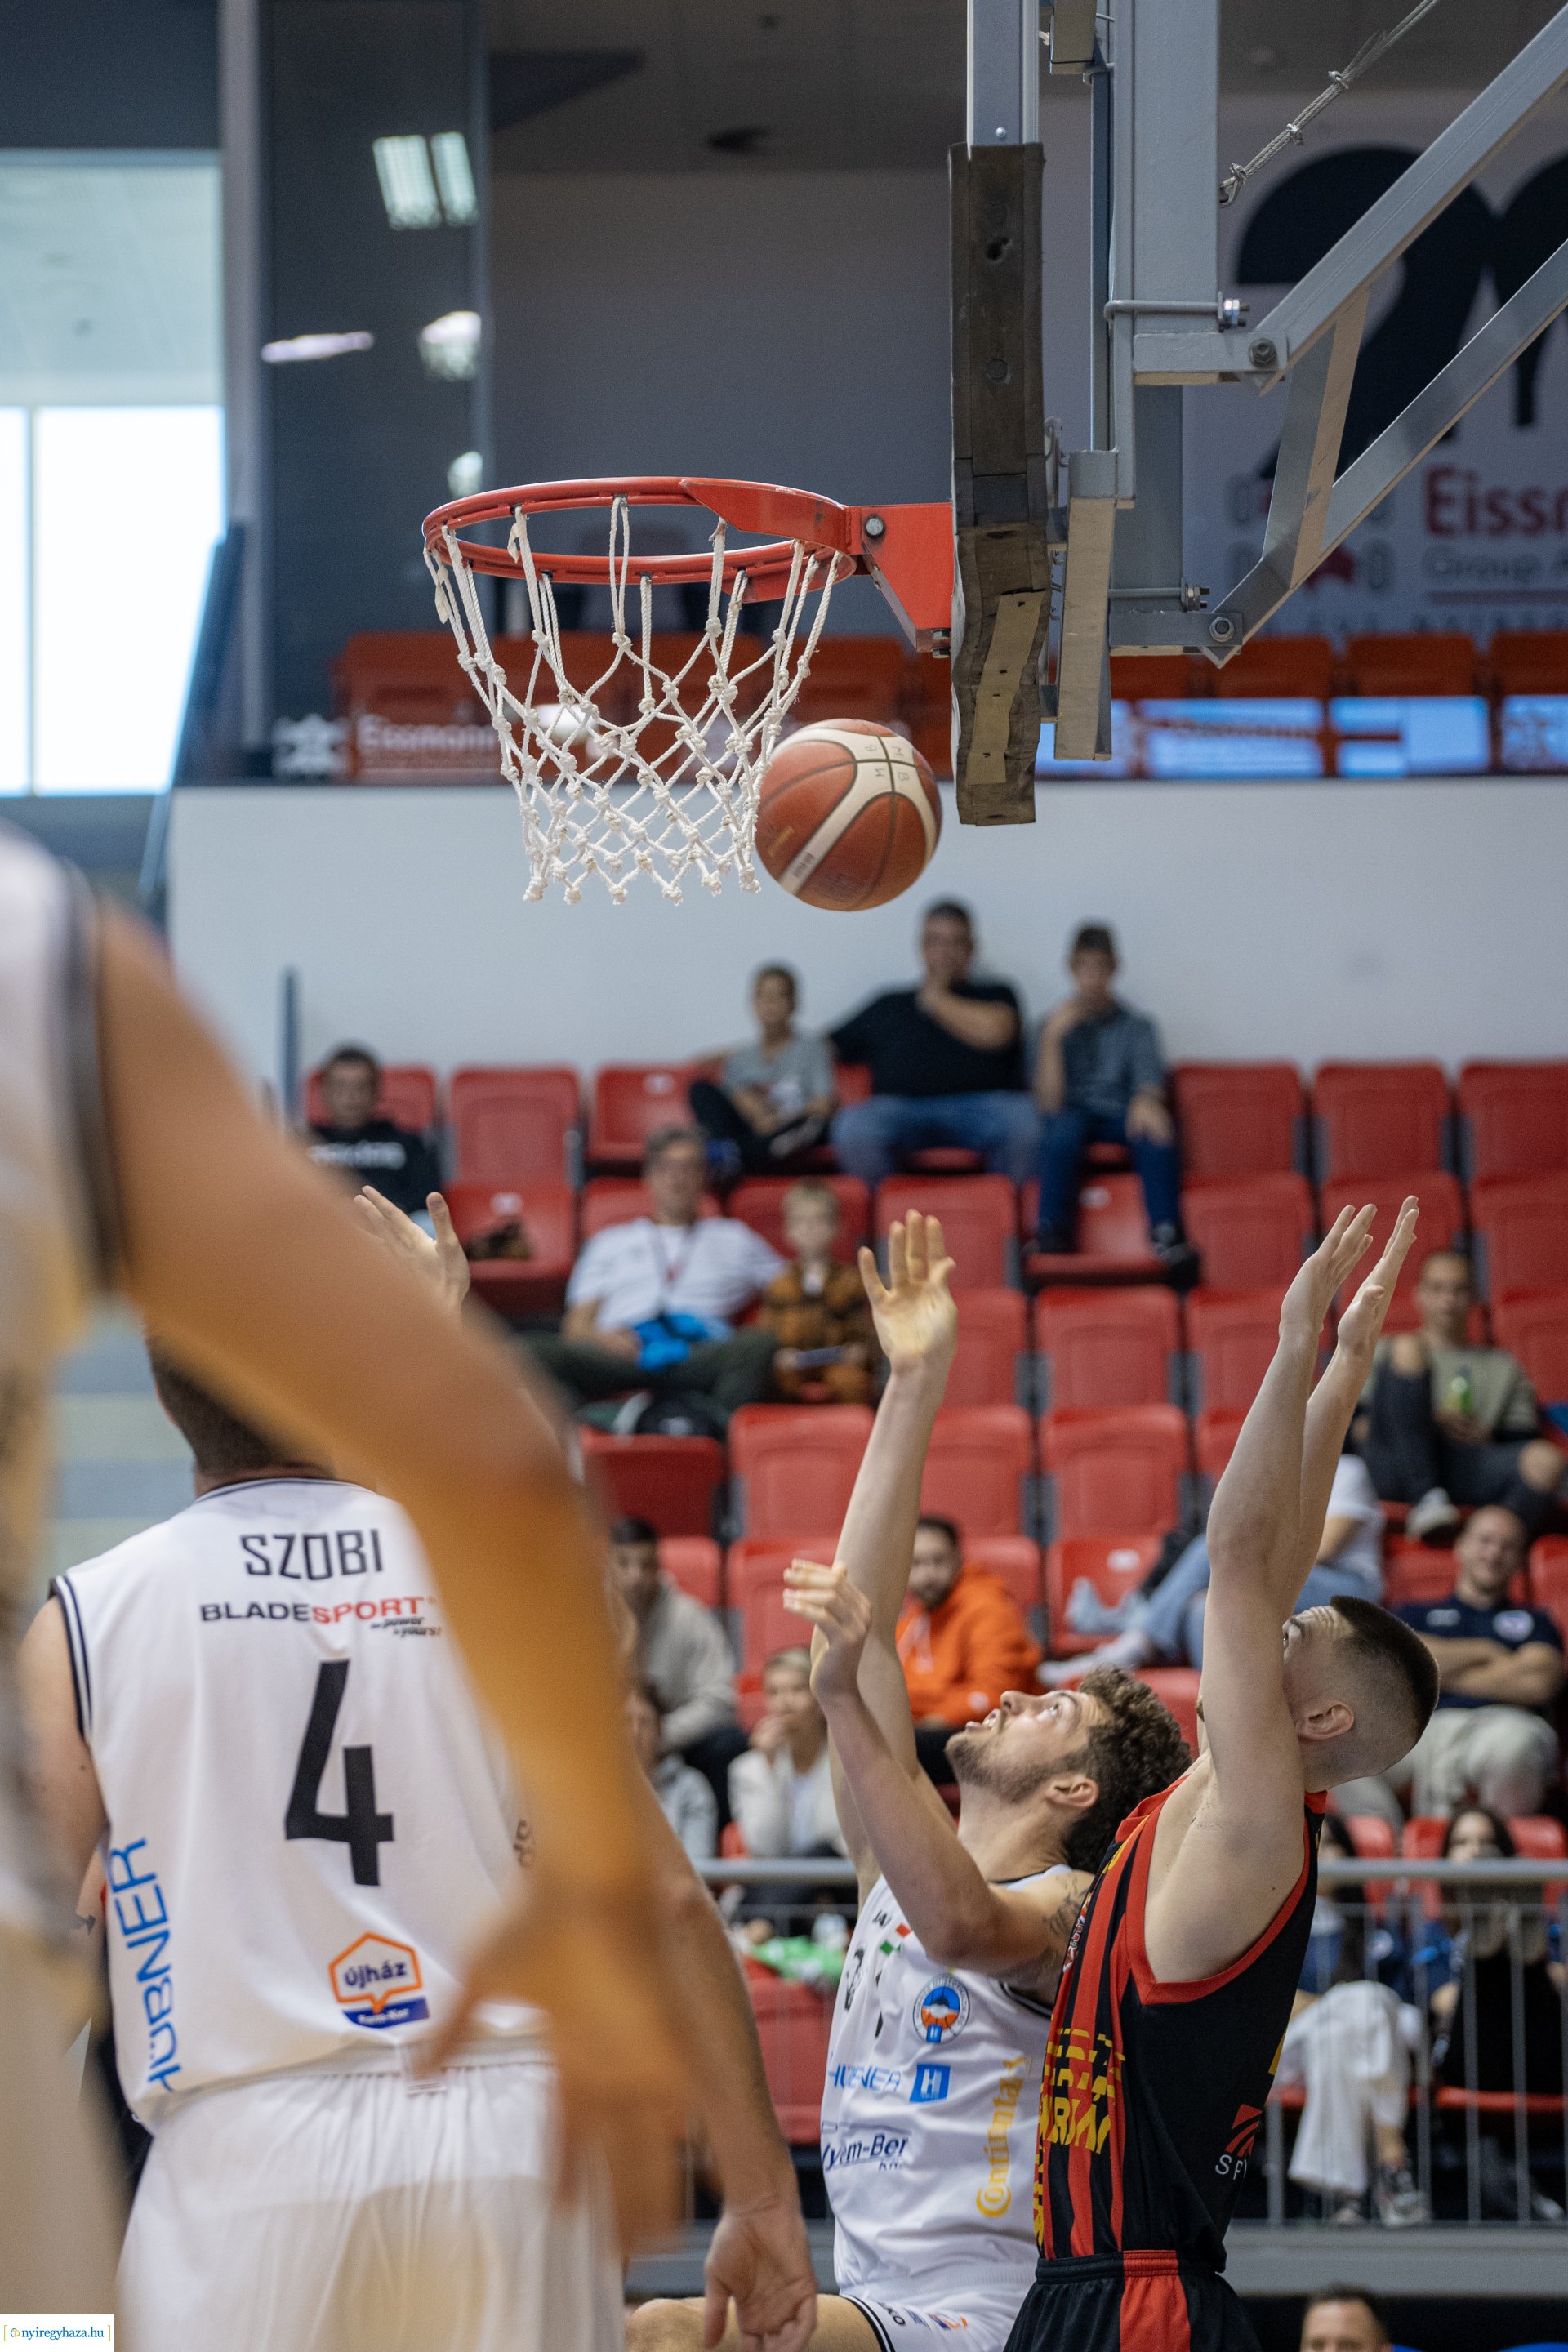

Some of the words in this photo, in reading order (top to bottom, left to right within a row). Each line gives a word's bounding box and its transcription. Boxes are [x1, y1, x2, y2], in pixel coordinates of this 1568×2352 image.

[1424, 464, 1568, 539] Eiss
[239, 1528, 384, 1581] SZOBI
[199, 1595, 425, 1624] BLADESPORT
[284, 1658, 395, 1886] 4
